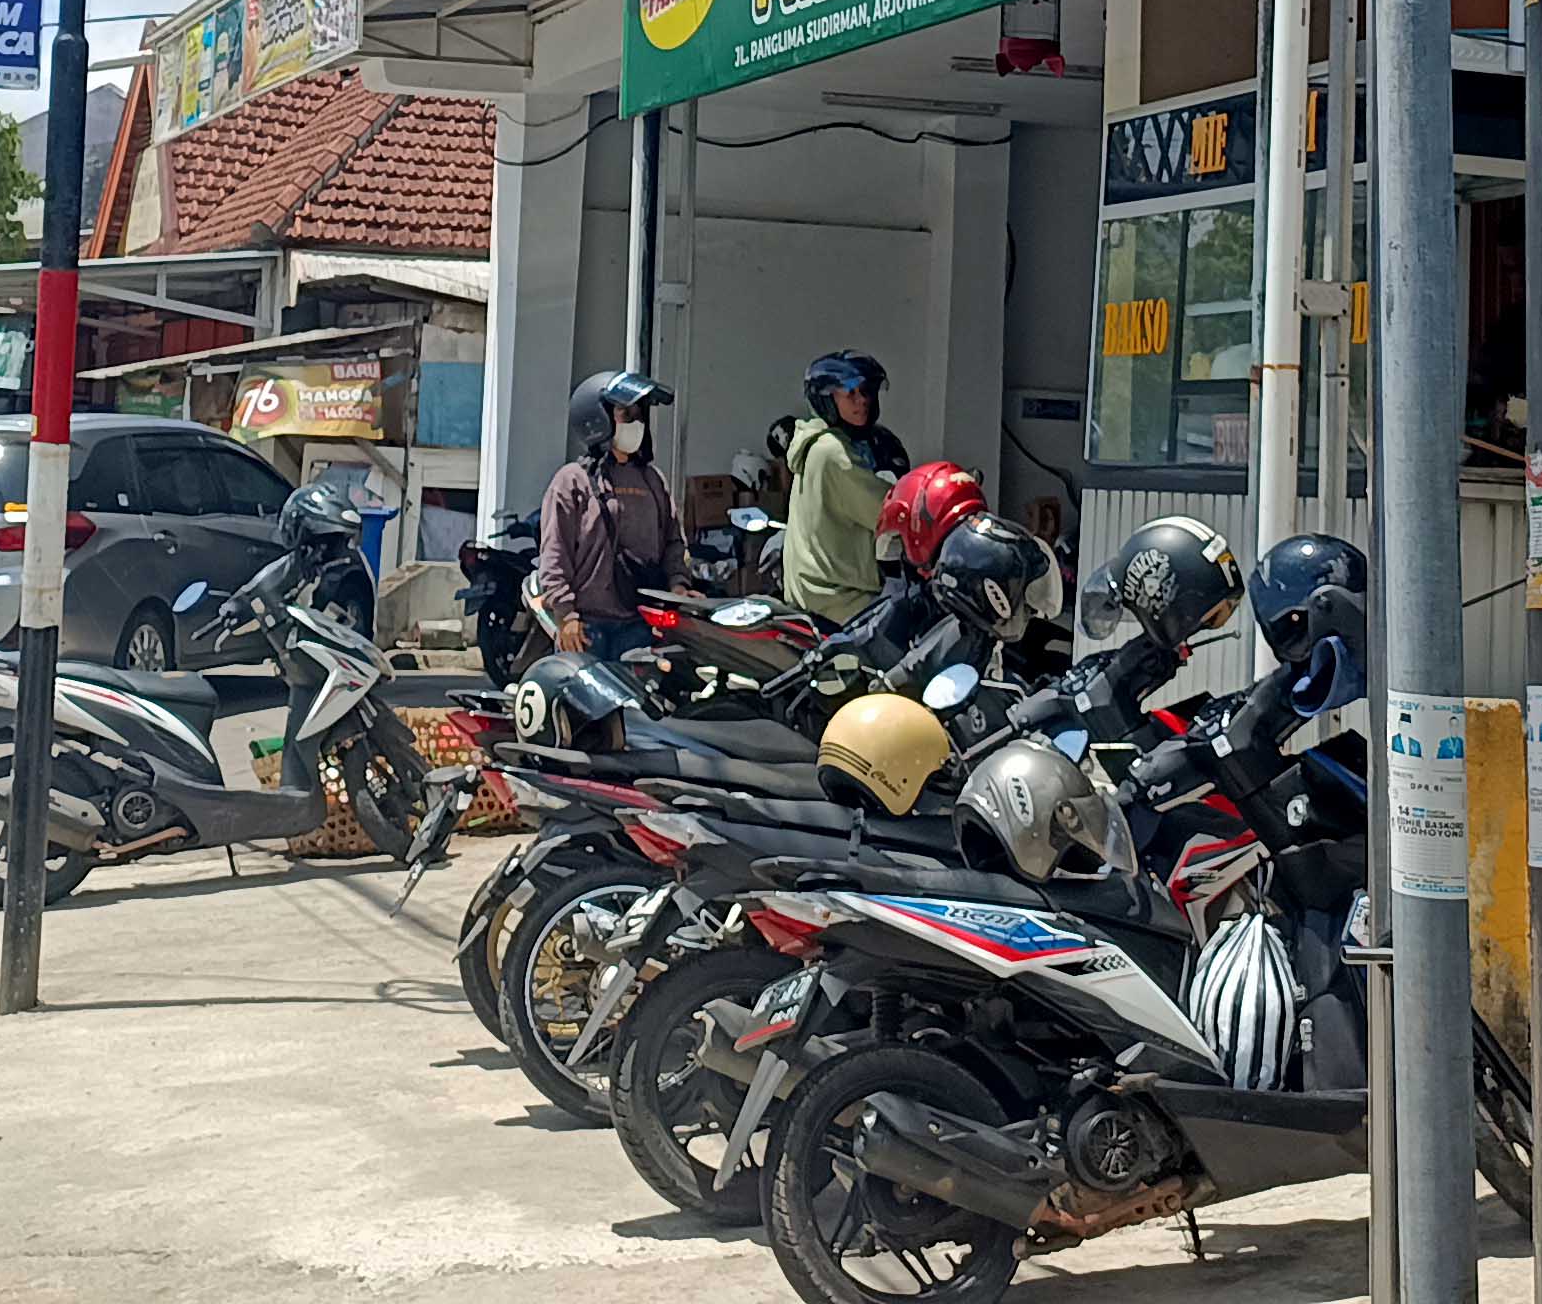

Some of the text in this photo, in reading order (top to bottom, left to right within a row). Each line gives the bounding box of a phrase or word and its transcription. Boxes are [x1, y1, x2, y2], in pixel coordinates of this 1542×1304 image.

[734, 46, 749, 68] JL.
[751, 25, 805, 60] PANGLIMA
[807, 5, 870, 45] SUDIRMAN,
[1188, 112, 1228, 175] MIE
[1103, 298, 1169, 356] BAKSO
[334, 363, 380, 378] BARU
[241, 379, 279, 428] 76
[519, 690, 535, 730] 5
[1012, 776, 1030, 817] INK
